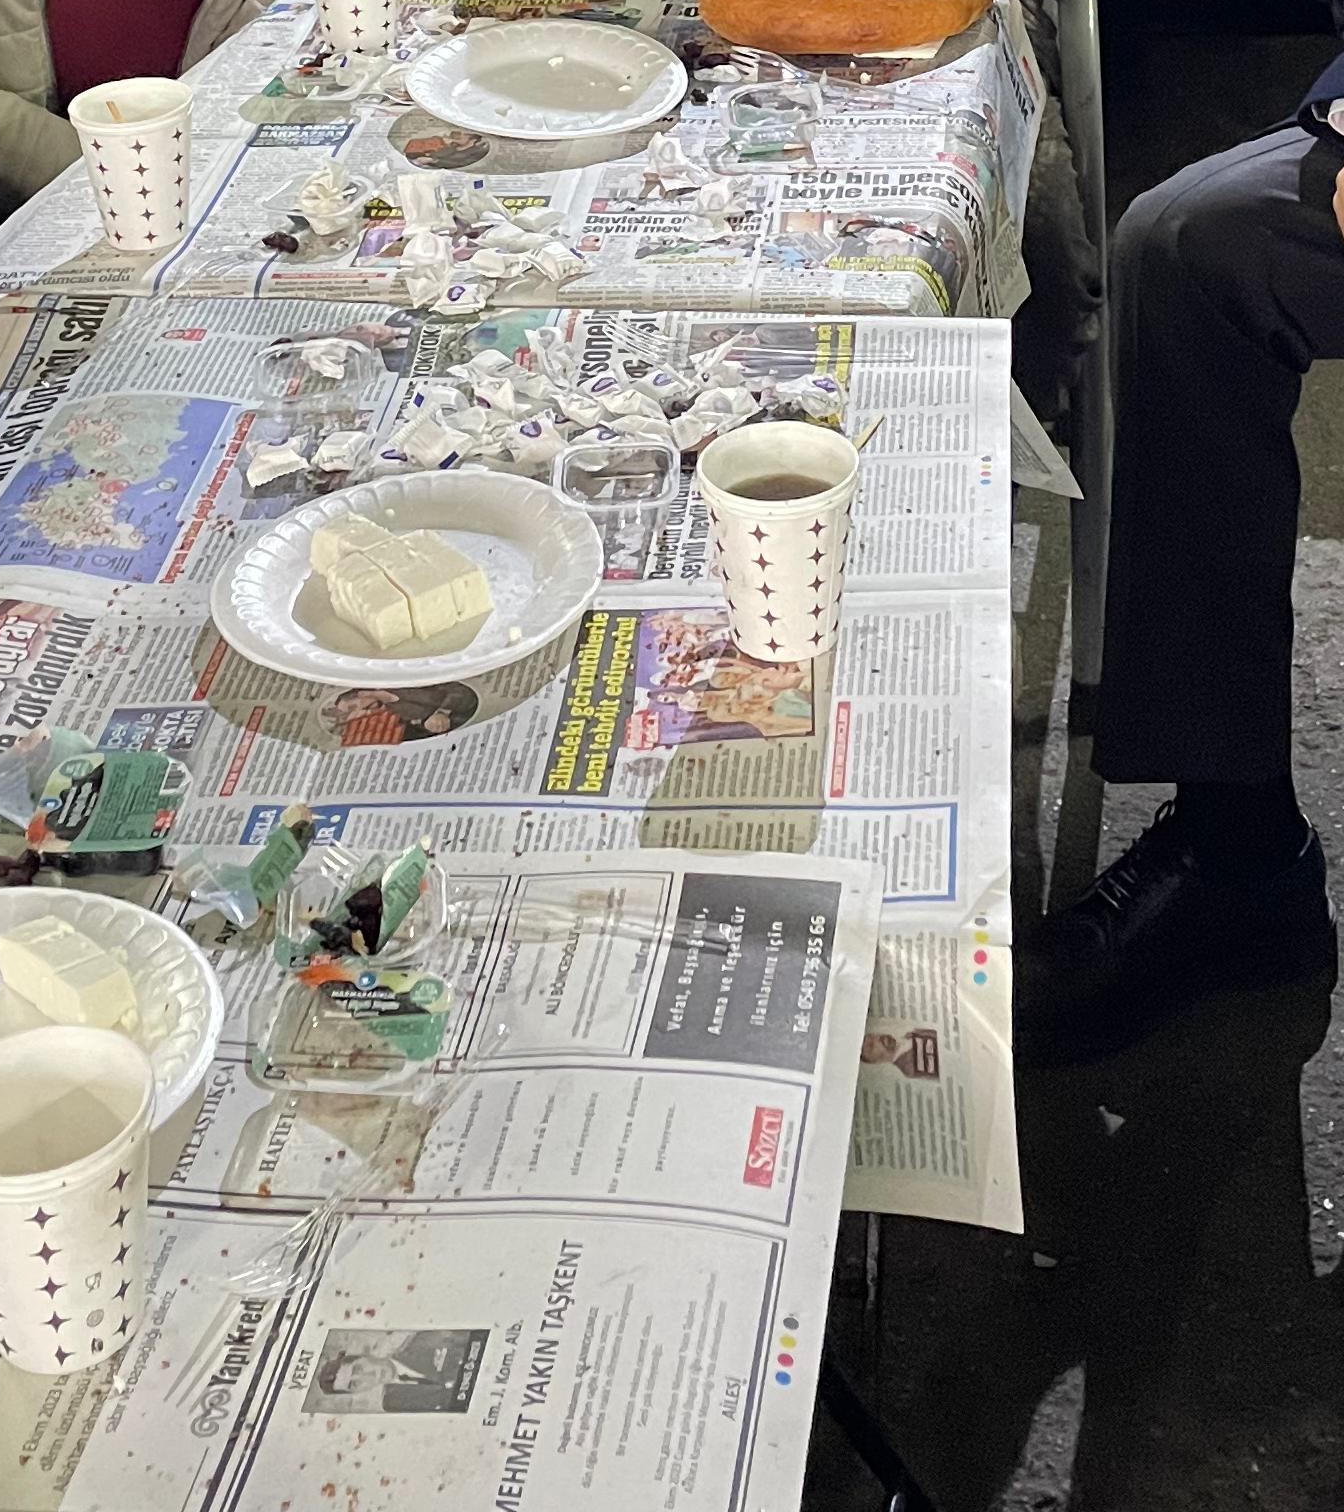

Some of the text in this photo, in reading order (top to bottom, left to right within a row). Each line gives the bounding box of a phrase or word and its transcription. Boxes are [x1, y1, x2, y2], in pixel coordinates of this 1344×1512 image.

[782, 185, 863, 201] böyle
[789, 172, 838, 185] 150
[846, 172, 890, 185] bin
[98, 272, 131, 283] oldu
[547, 612, 610, 791] Elindeki görüntülerle
[592, 698, 620, 755] tehdit
[577, 747, 608, 792] beni
[766, 920, 784, 947] için
[807, 915, 827, 934] 66
[805, 937, 824, 955] 35
[719, 975, 733, 991] ve
[539, 1239, 585, 1334] TAŞKENT
[204, 1296, 276, 1386] YapıKred
[288, 1349, 316, 1391] VEFAT
[521, 1338, 561, 1409] YAKIN
